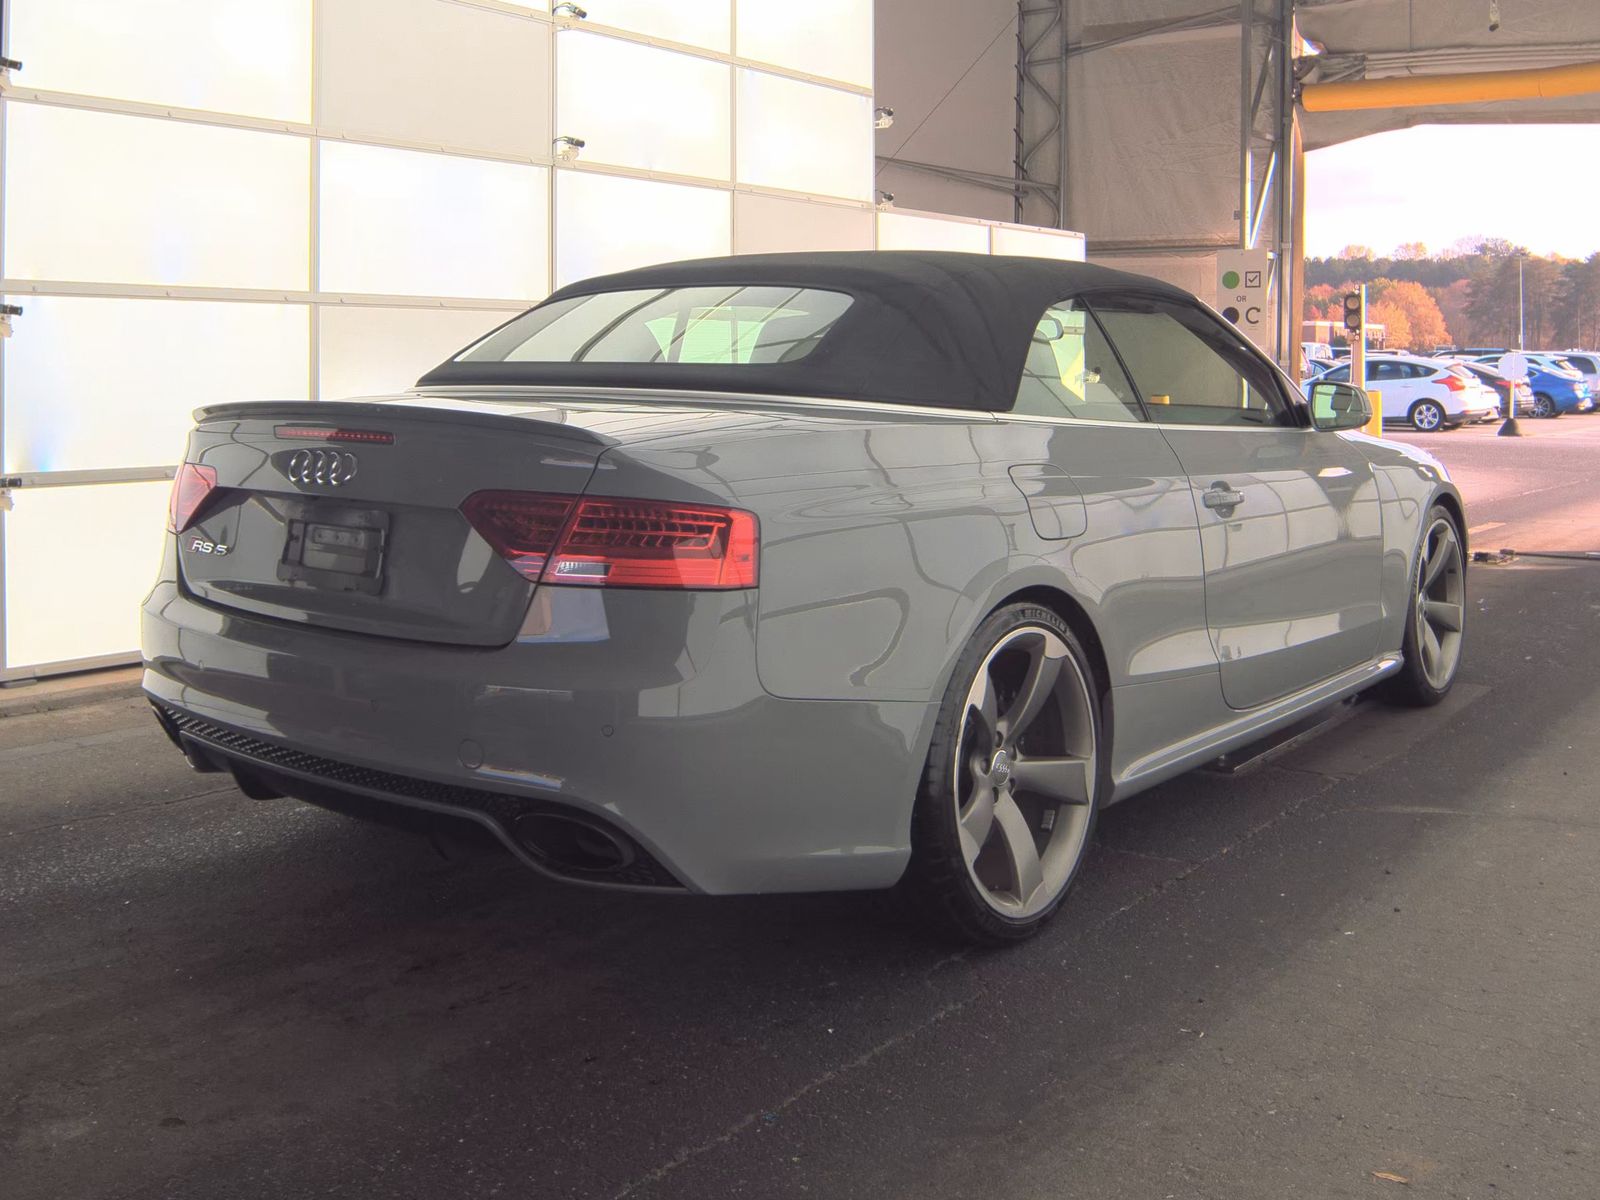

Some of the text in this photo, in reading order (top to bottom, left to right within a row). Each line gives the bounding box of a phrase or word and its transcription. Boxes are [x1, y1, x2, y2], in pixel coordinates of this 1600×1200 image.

[1236, 295, 1247, 303] OR
[191, 540, 214, 554] RS
[1024, 609, 1066, 632] MICHELIN
